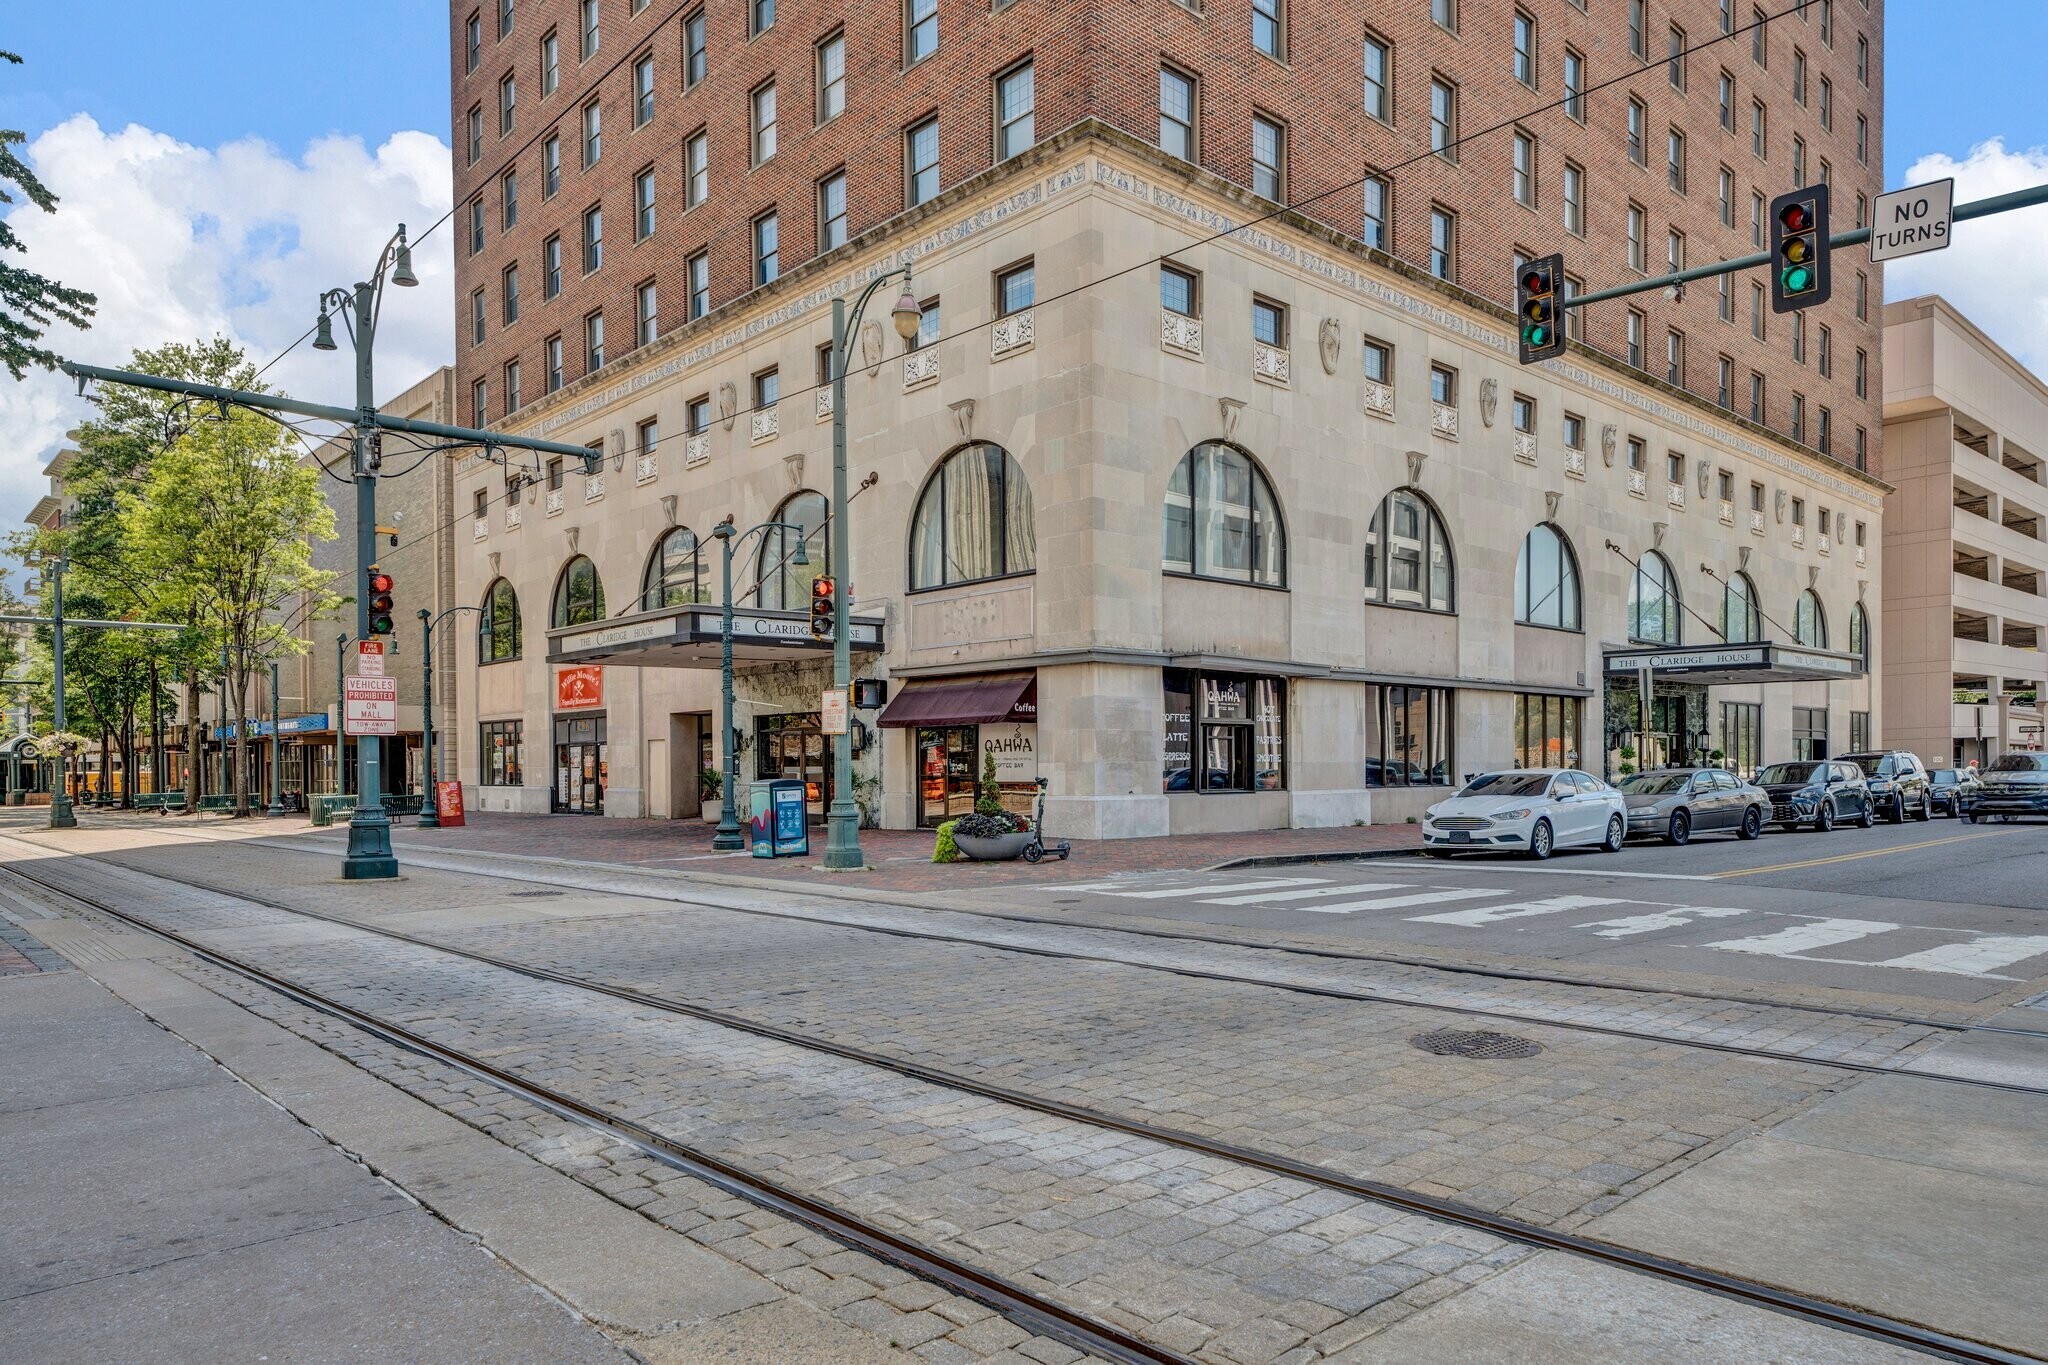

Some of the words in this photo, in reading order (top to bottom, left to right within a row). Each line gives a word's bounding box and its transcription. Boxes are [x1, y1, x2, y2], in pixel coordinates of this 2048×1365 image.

[1895, 199, 1929, 223] NO
[1876, 221, 1946, 250] TURNS
[717, 620, 741, 631] TE
[754, 619, 811, 636] CLARIDG
[596, 630, 627, 646] CLARIDGE
[1619, 660, 1638, 668] THE
[1649, 655, 1704, 667] CLARIDGE
[1717, 653, 1751, 663] HOUSE
[349, 680, 393, 690] VEHICLES
[348, 691, 393, 700] PROHIBITED
[1207, 690, 1241, 703] QAHWA
[366, 702, 377, 710] ON
[1014, 702, 1036, 713] Coffee
[361, 711, 381, 719] MALL
[984, 738, 1033, 754] QAHWA
